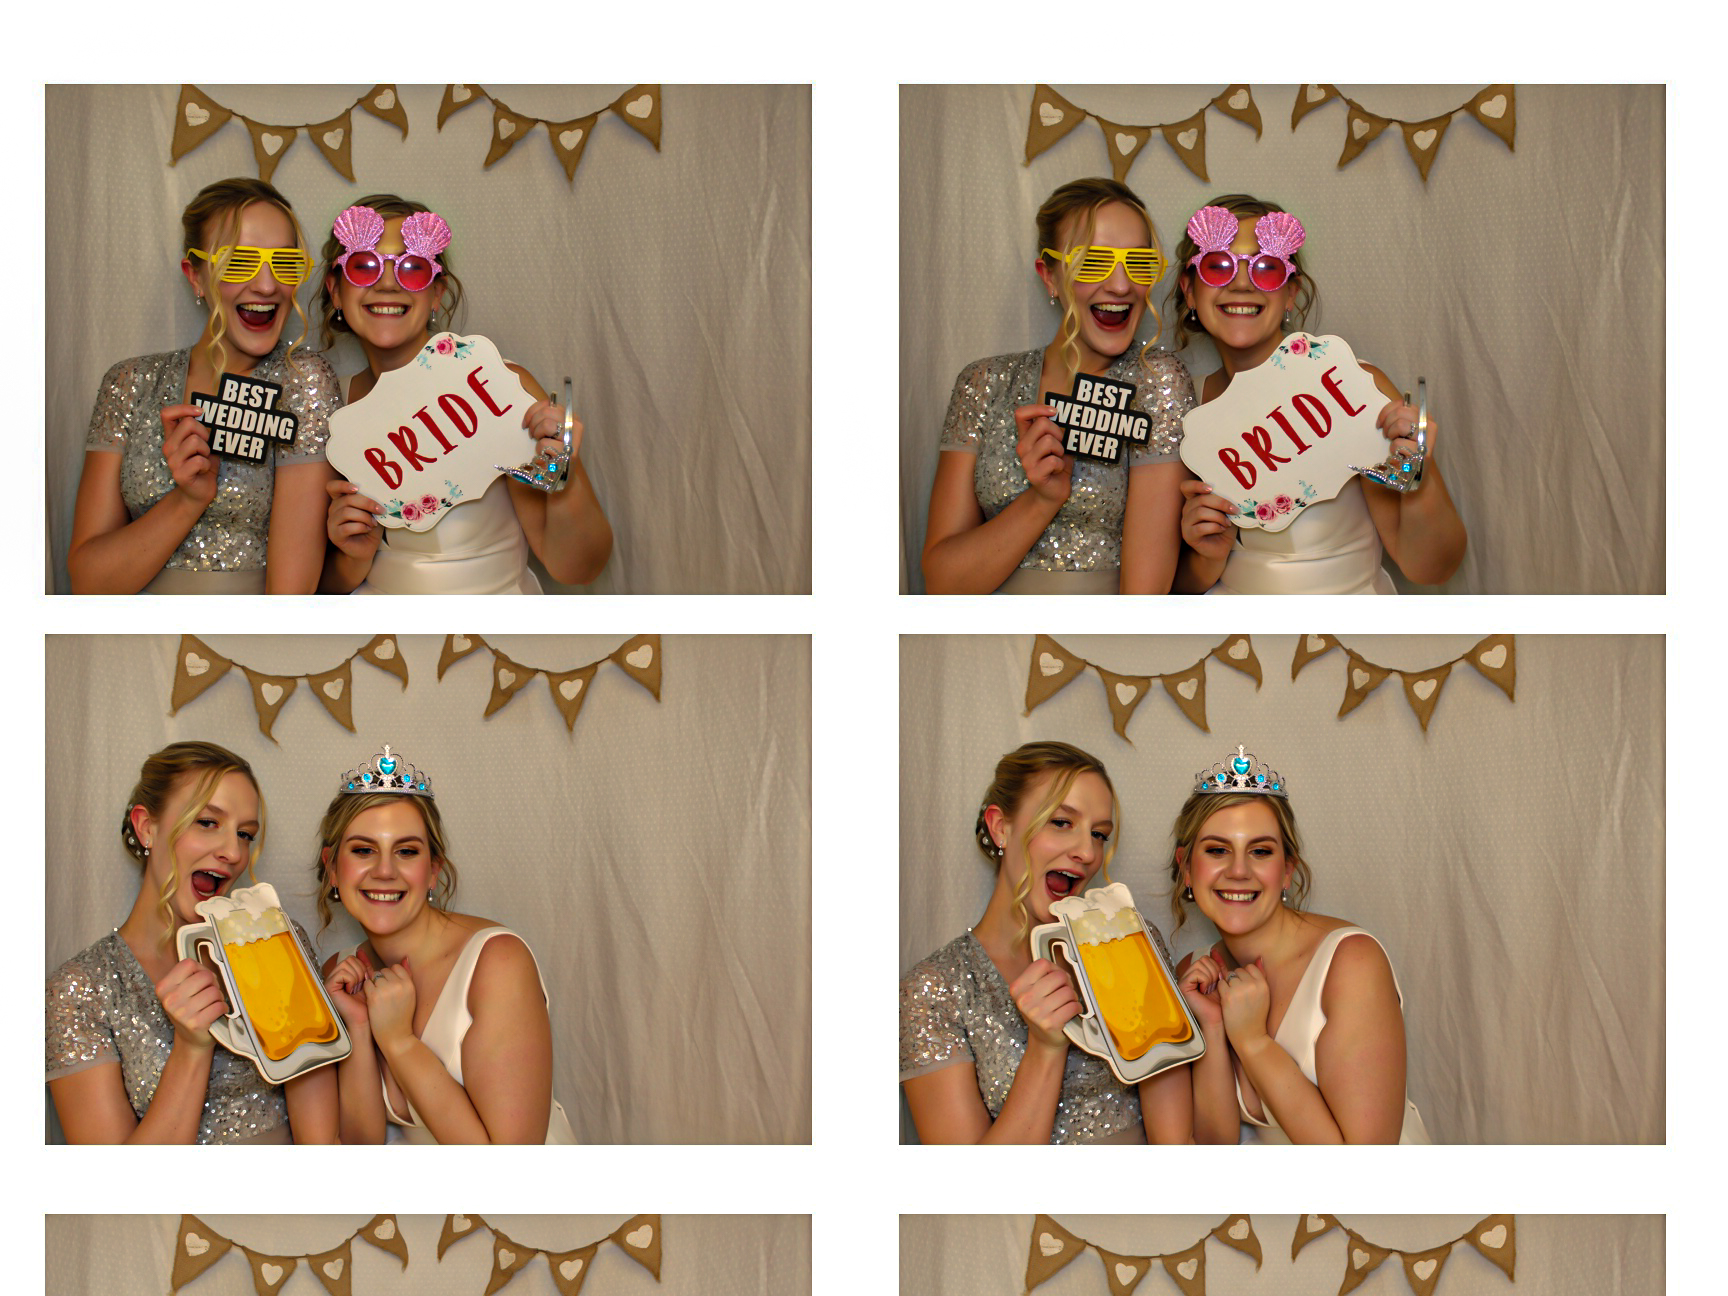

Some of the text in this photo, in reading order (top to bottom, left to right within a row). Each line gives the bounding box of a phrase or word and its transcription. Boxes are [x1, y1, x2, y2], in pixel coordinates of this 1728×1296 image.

[222, 379, 278, 410] BEST
[1076, 379, 1132, 410] BEST
[195, 398, 294, 440] WEDDING
[364, 366, 512, 490] BRIDE
[1049, 398, 1148, 440] WEDDING
[1218, 366, 1366, 490] BRIDE
[212, 428, 265, 460] EVER
[1066, 428, 1119, 460] EVER
